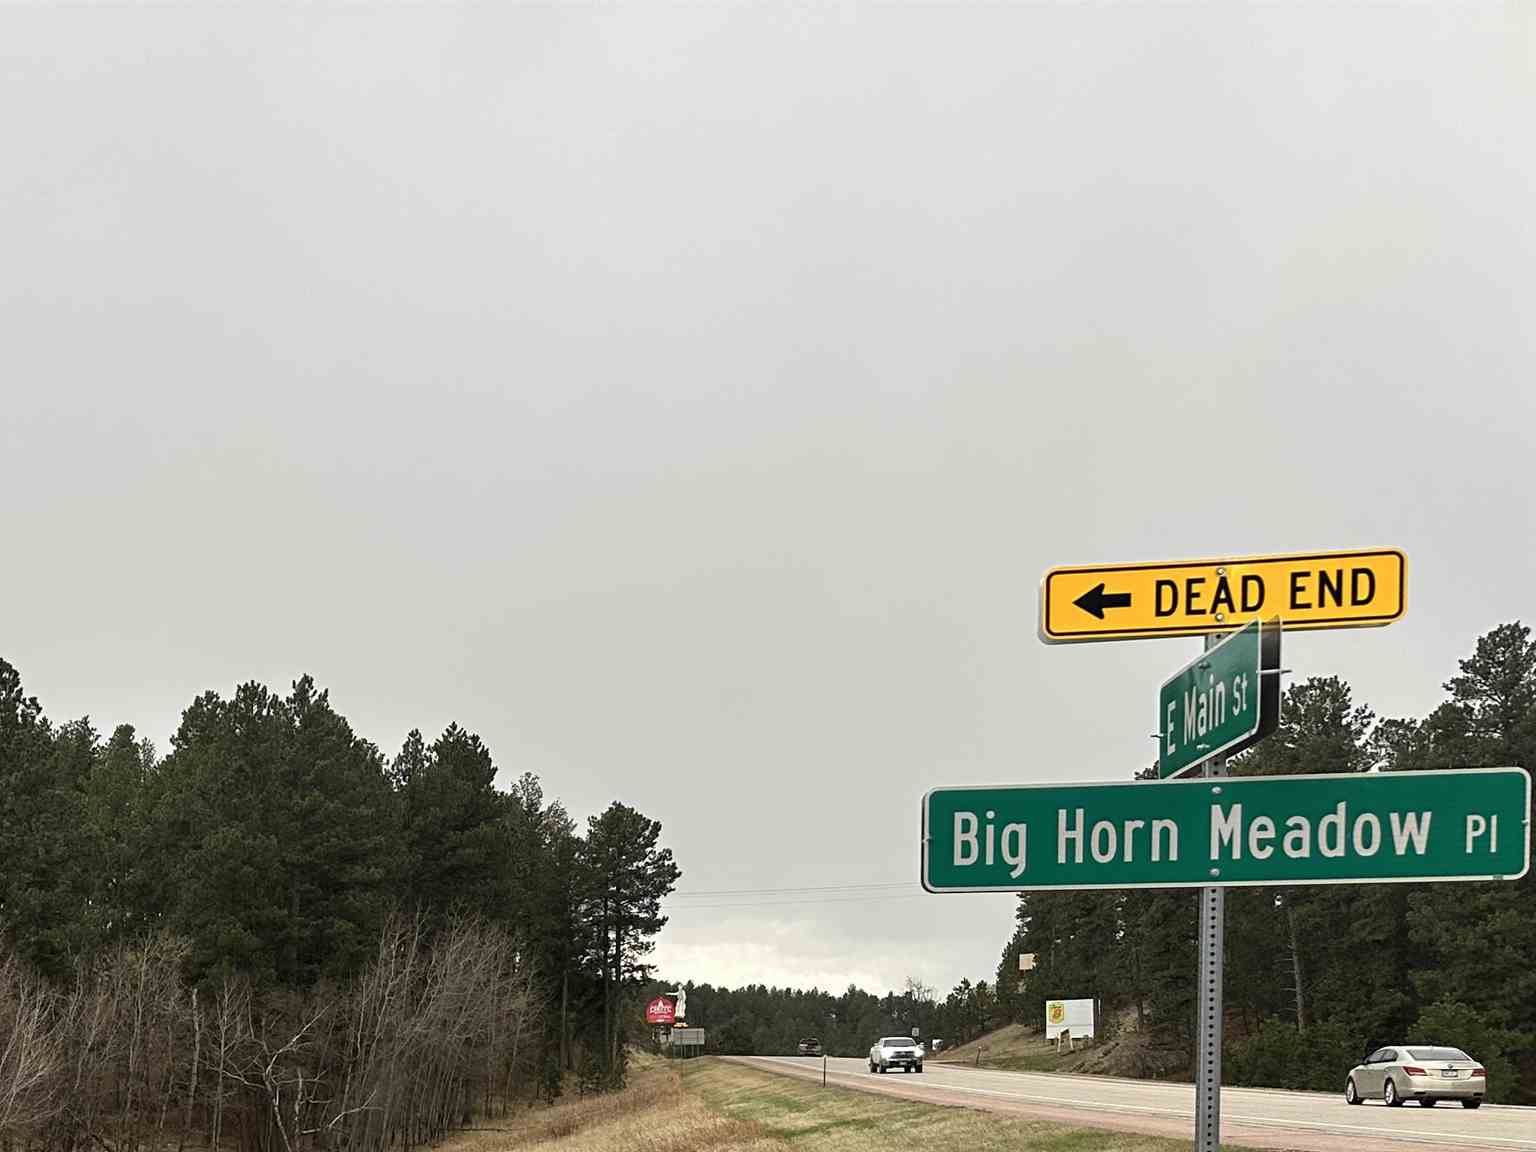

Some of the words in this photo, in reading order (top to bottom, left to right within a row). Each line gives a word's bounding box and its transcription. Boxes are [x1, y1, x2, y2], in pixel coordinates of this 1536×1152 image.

[1155, 574, 1265, 617] DEAD
[1290, 567, 1376, 609] END
[1166, 701, 1177, 755] E
[1184, 674, 1226, 745] Main
[1232, 673, 1248, 716] St
[953, 811, 1028, 879] Big
[1056, 808, 1179, 865] Horn
[1210, 801, 1433, 861] Meadow
[1466, 814, 1498, 854] Pl
